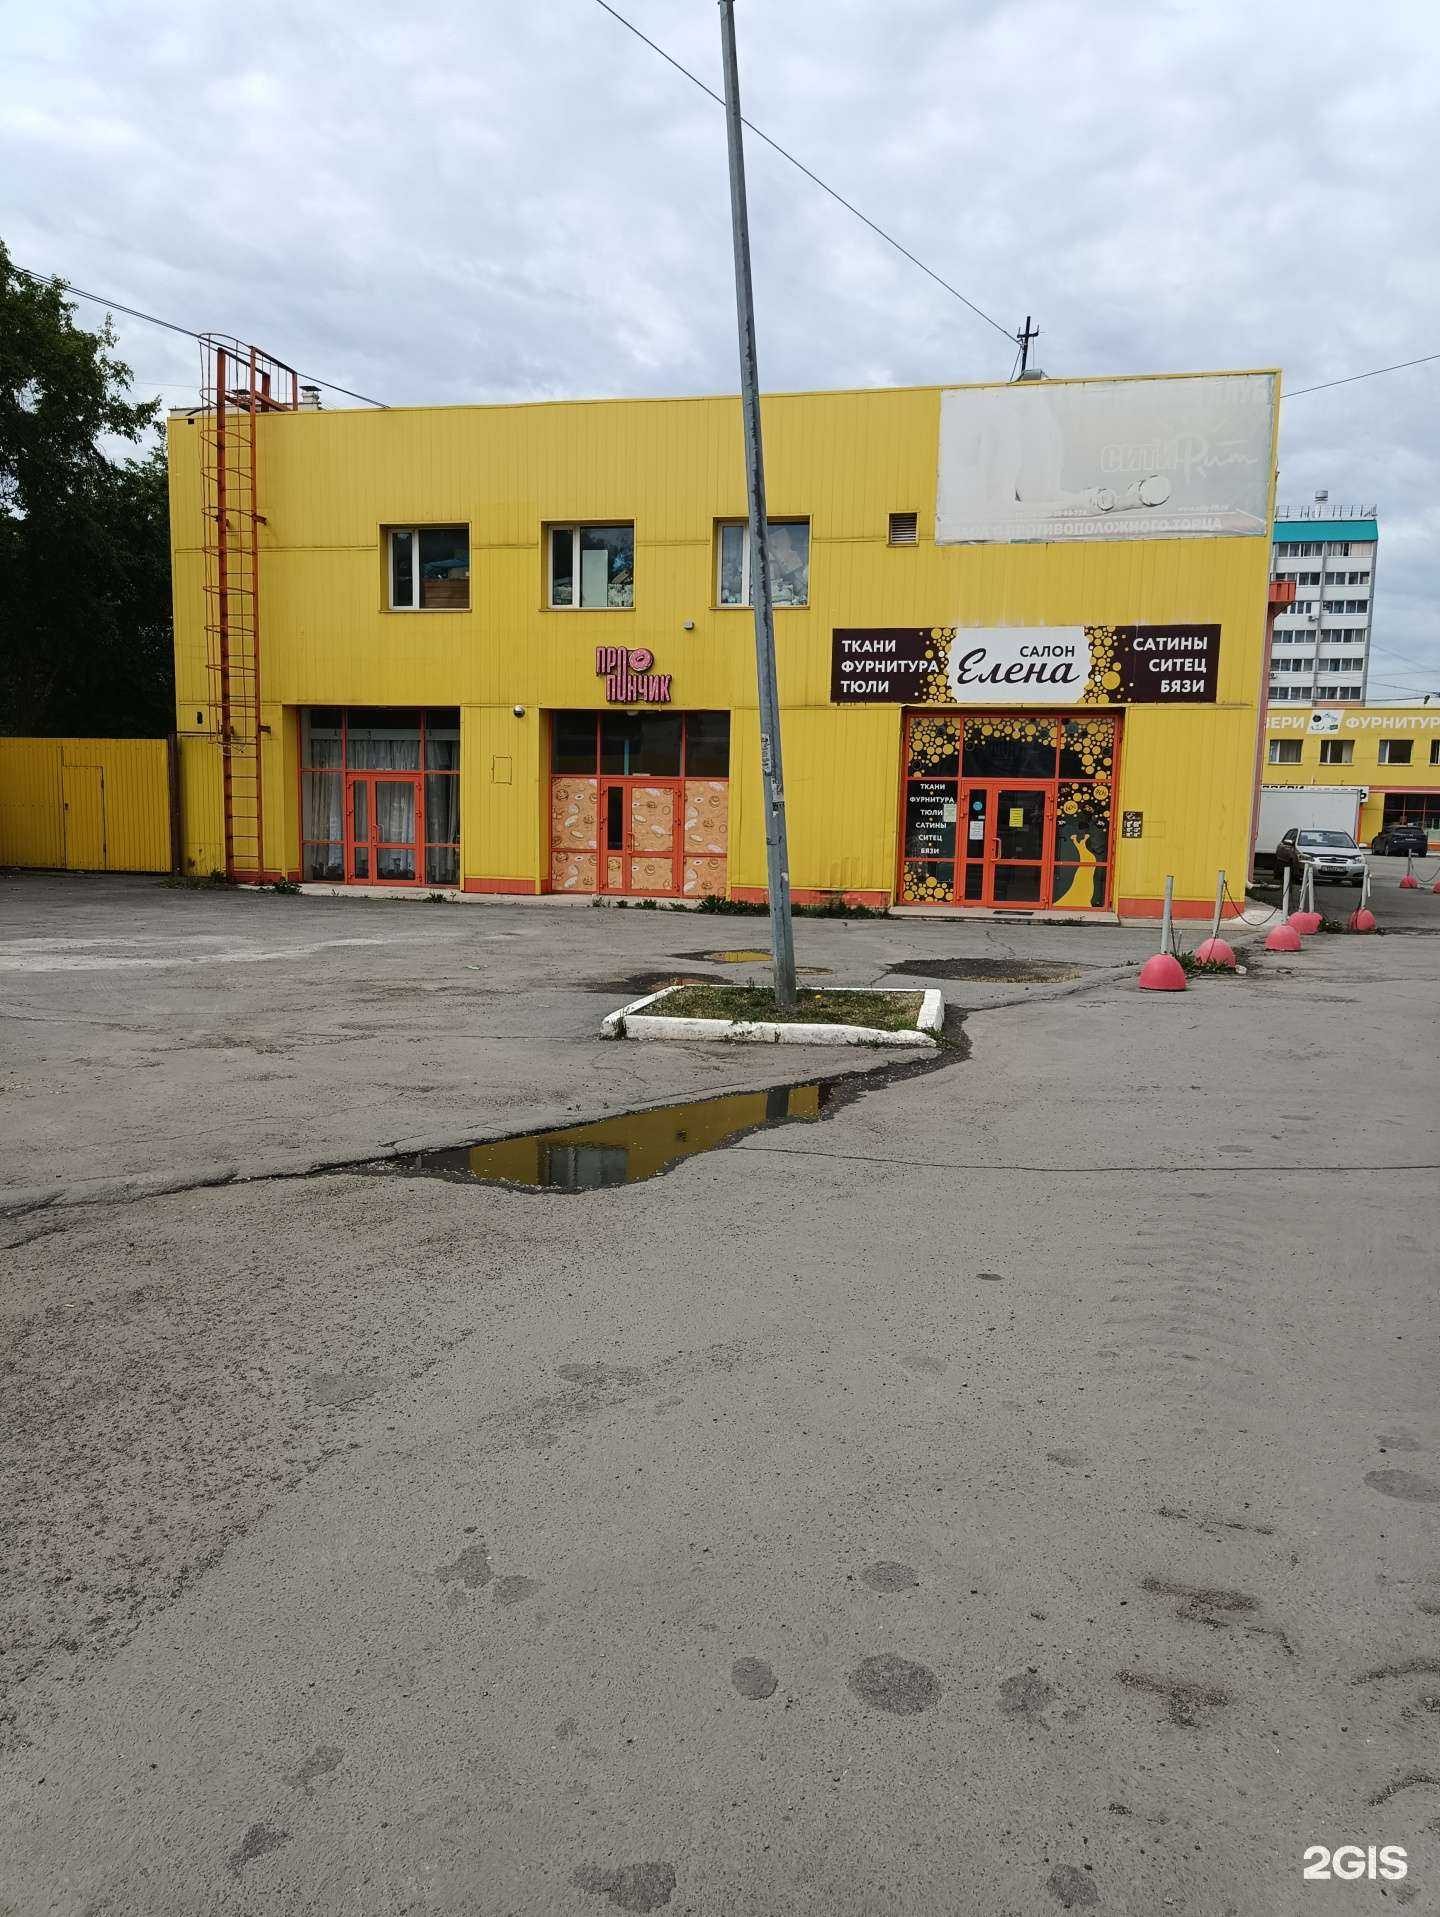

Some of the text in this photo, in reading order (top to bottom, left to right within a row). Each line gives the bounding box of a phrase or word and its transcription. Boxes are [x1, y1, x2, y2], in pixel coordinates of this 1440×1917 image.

[841, 640, 896, 652] ТКАНИ
[1132, 636, 1207, 651] САТИНЫ
[1019, 645, 1075, 657] САЛОН
[841, 660, 940, 673] ФУРНИТУРА
[957, 647, 1080, 684] Елена
[1148, 658, 1207, 673] СИТЕЦ
[606, 674, 673, 702] ПОНЧИК
[840, 680, 889, 693] ТЮЛИ
[1160, 679, 1205, 693] БЯЗИ
[1346, 717, 1440, 729] ФУРНИТУР
[918, 834, 943, 842] СИТЕЦ
